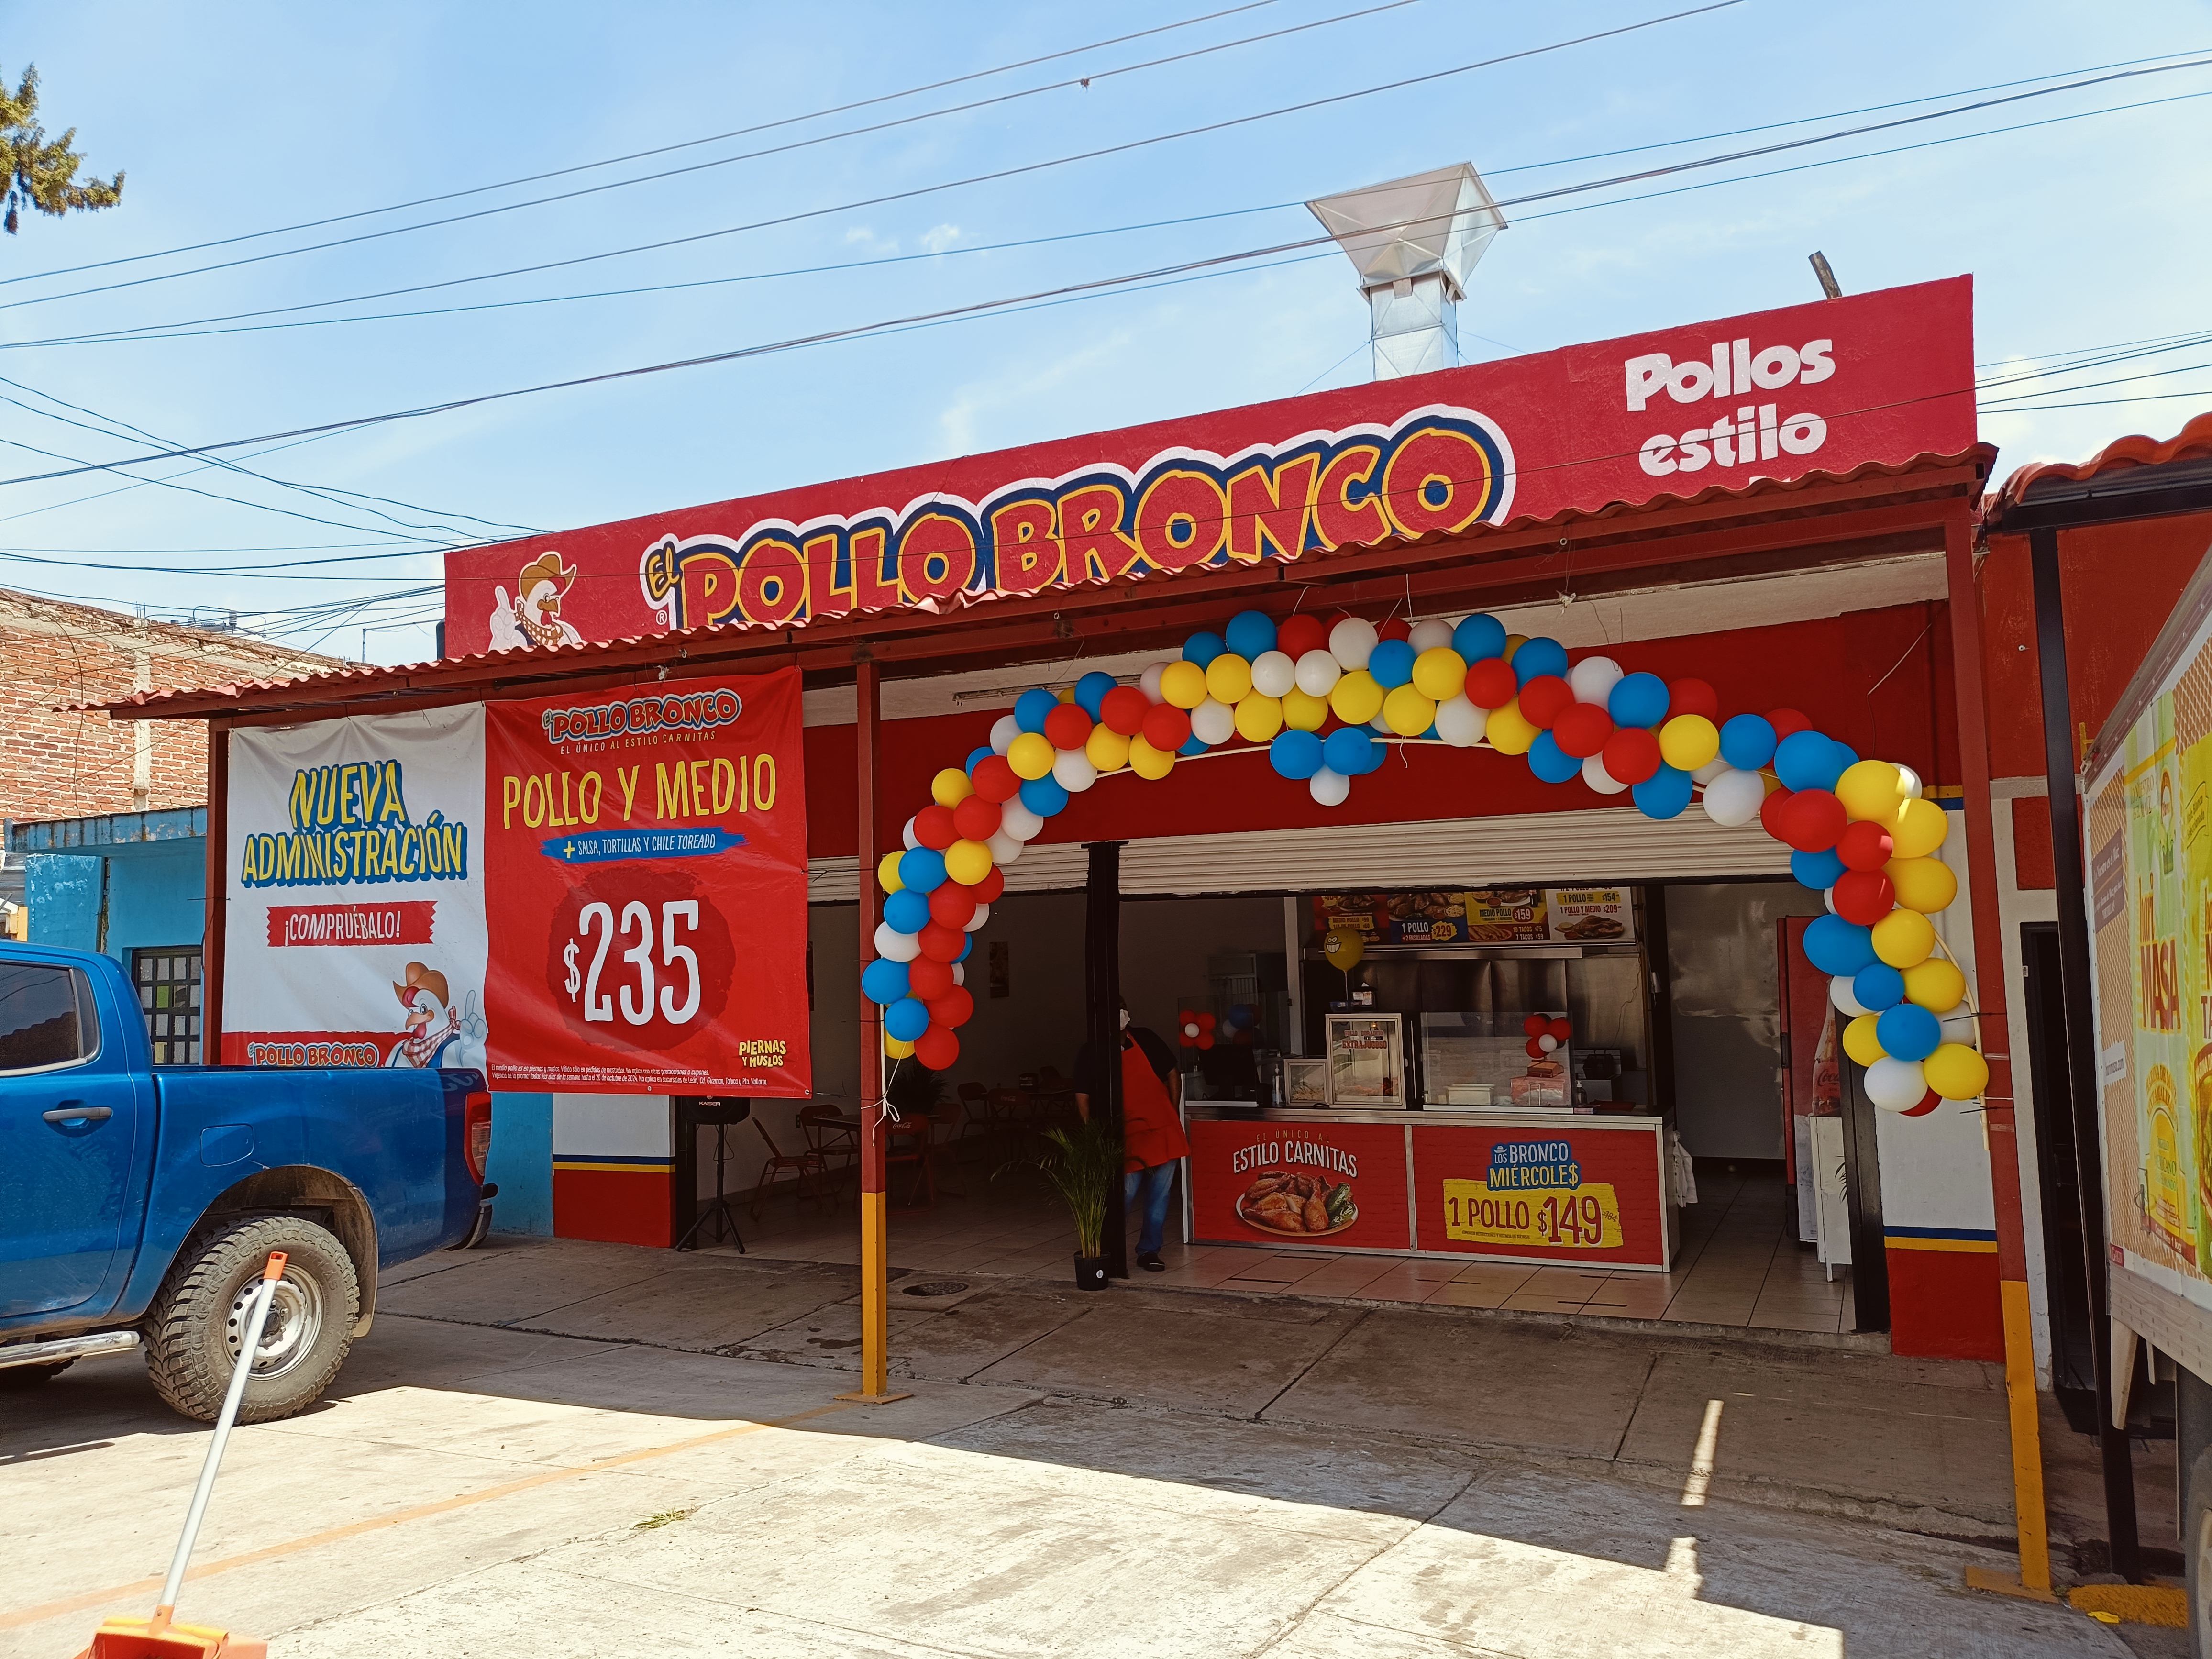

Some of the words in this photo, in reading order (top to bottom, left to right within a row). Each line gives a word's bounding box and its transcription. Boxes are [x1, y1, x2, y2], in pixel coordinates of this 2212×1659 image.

[1625, 337, 1836, 411] Pollos
[1638, 403, 1827, 477] estilo
[646, 541, 679, 600] El
[679, 513, 976, 627] POLLO
[992, 427, 1492, 592] BRONCO
[553, 706, 627, 740] POLLO
[628, 693, 738, 729] BRONCO
[560, 746, 570, 754] EL
[576, 742, 606, 753] ÚNICO
[610, 741, 620, 750] AL
[625, 736, 658, 748] ESTILO
[663, 730, 716, 743] CARNITAS
[290, 761, 405, 828] NUEVA
[503, 770, 604, 829] POLLO
[617, 764, 640, 821] Y
[656, 753, 776, 820] MEDIO
[242, 811, 463, 881] ADMINISTRACIÓN
[578, 840, 601, 856] SALSA,
[603, 838, 641, 854] TORTILLAS
[643, 837, 649, 851] Y
[652, 835, 675, 851] CHILE
[678, 834, 716, 850] TOREADO
[1563, 895, 1567, 903] 1
[1569, 894, 1586, 903] POLLO
[1602, 893, 1615, 902] $154
[1603, 904, 1617, 913] $209
[285, 905, 401, 947] ¡COMPRUÉBALO!
[1480, 909, 1495, 917] MEDIO
[1514, 909, 1531, 920] $159
[1402, 923, 1406, 933] 1
[1407, 922, 1429, 933] POLLO
[1433, 925, 1451, 937] $229
[564, 900, 701, 1026] $235
[2140, 939, 2181, 1031] MASA
[254, 1046, 306, 1066] POLLO
[307, 1046, 377, 1067] BRONCO
[739, 1039, 786, 1056] PIERNAS
[1342, 1040, 1387, 1049] EXTRAJUGOSO
[742, 1056, 747, 1066] Y
[749, 1054, 783, 1068] MUSLOS
[1257, 1132, 1267, 1142] EL
[1275, 1128, 1309, 1139] ÚNICO
[1318, 1133, 1330, 1143] AL
[1233, 1141, 1279, 1173] ESTILO
[1285, 1140, 1358, 1177] CARNITAS
[1494, 1153, 1507, 1164] LOS
[1509, 1142, 1569, 1164] BRONCO
[1448, 1197, 1460, 1227] 1
[1468, 1198, 1530, 1229] POLLO
[1537, 1195, 1602, 1244] $149
[2175, 1237, 2182, 1253] kg
